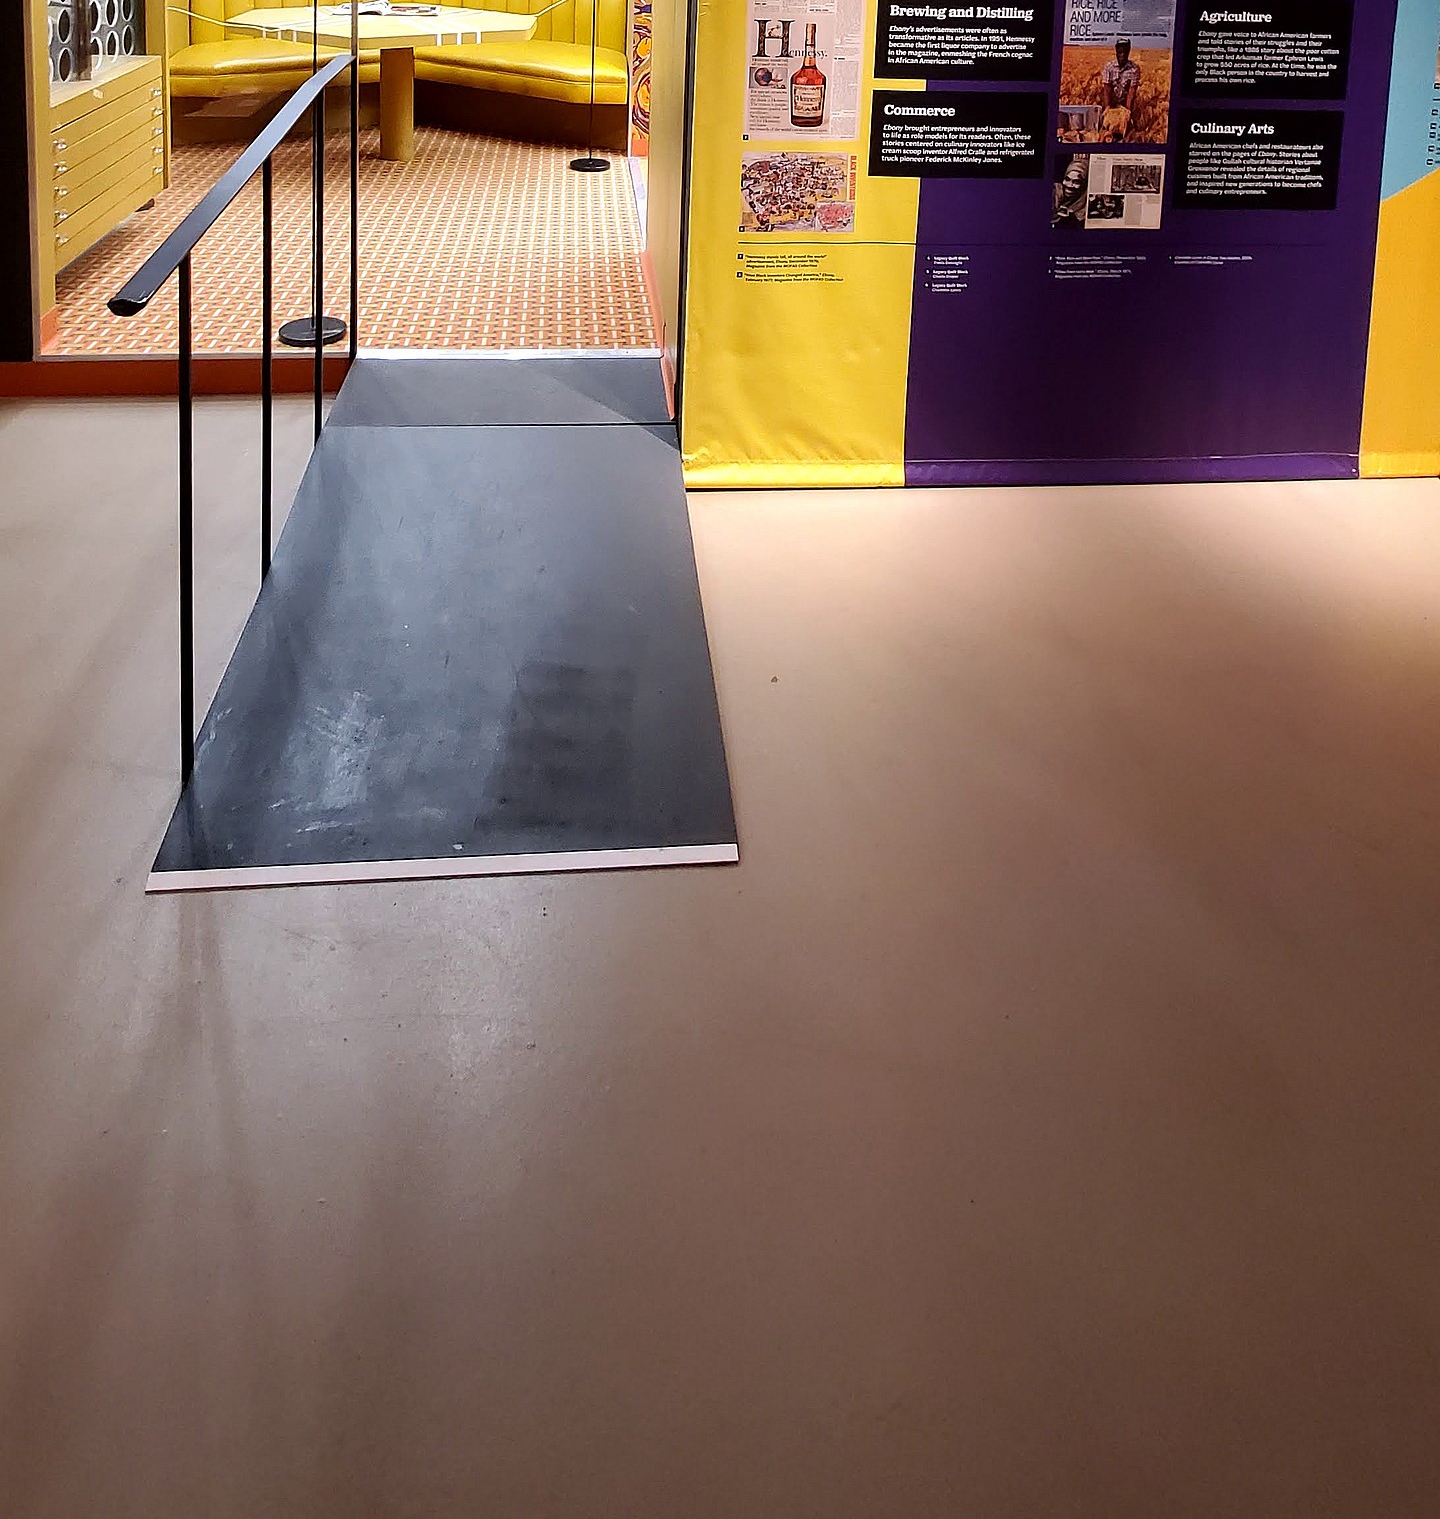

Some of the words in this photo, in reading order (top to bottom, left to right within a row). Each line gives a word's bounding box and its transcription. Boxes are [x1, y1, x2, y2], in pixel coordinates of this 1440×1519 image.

[889, 4, 947, 20] Brewing
[948, 6, 974, 18] and
[975, 6, 1034, 22] Distilling
[1069, 10, 1092, 23] AND
[1093, 10, 1122, 23] MORE
[1199, 10, 1272, 24] Agriculture
[1069, 24, 1092, 37] RICE
[883, 104, 956, 117] Commerce
[1190, 122, 1246, 136] Culinary
[1247, 123, 1274, 134] Arts
